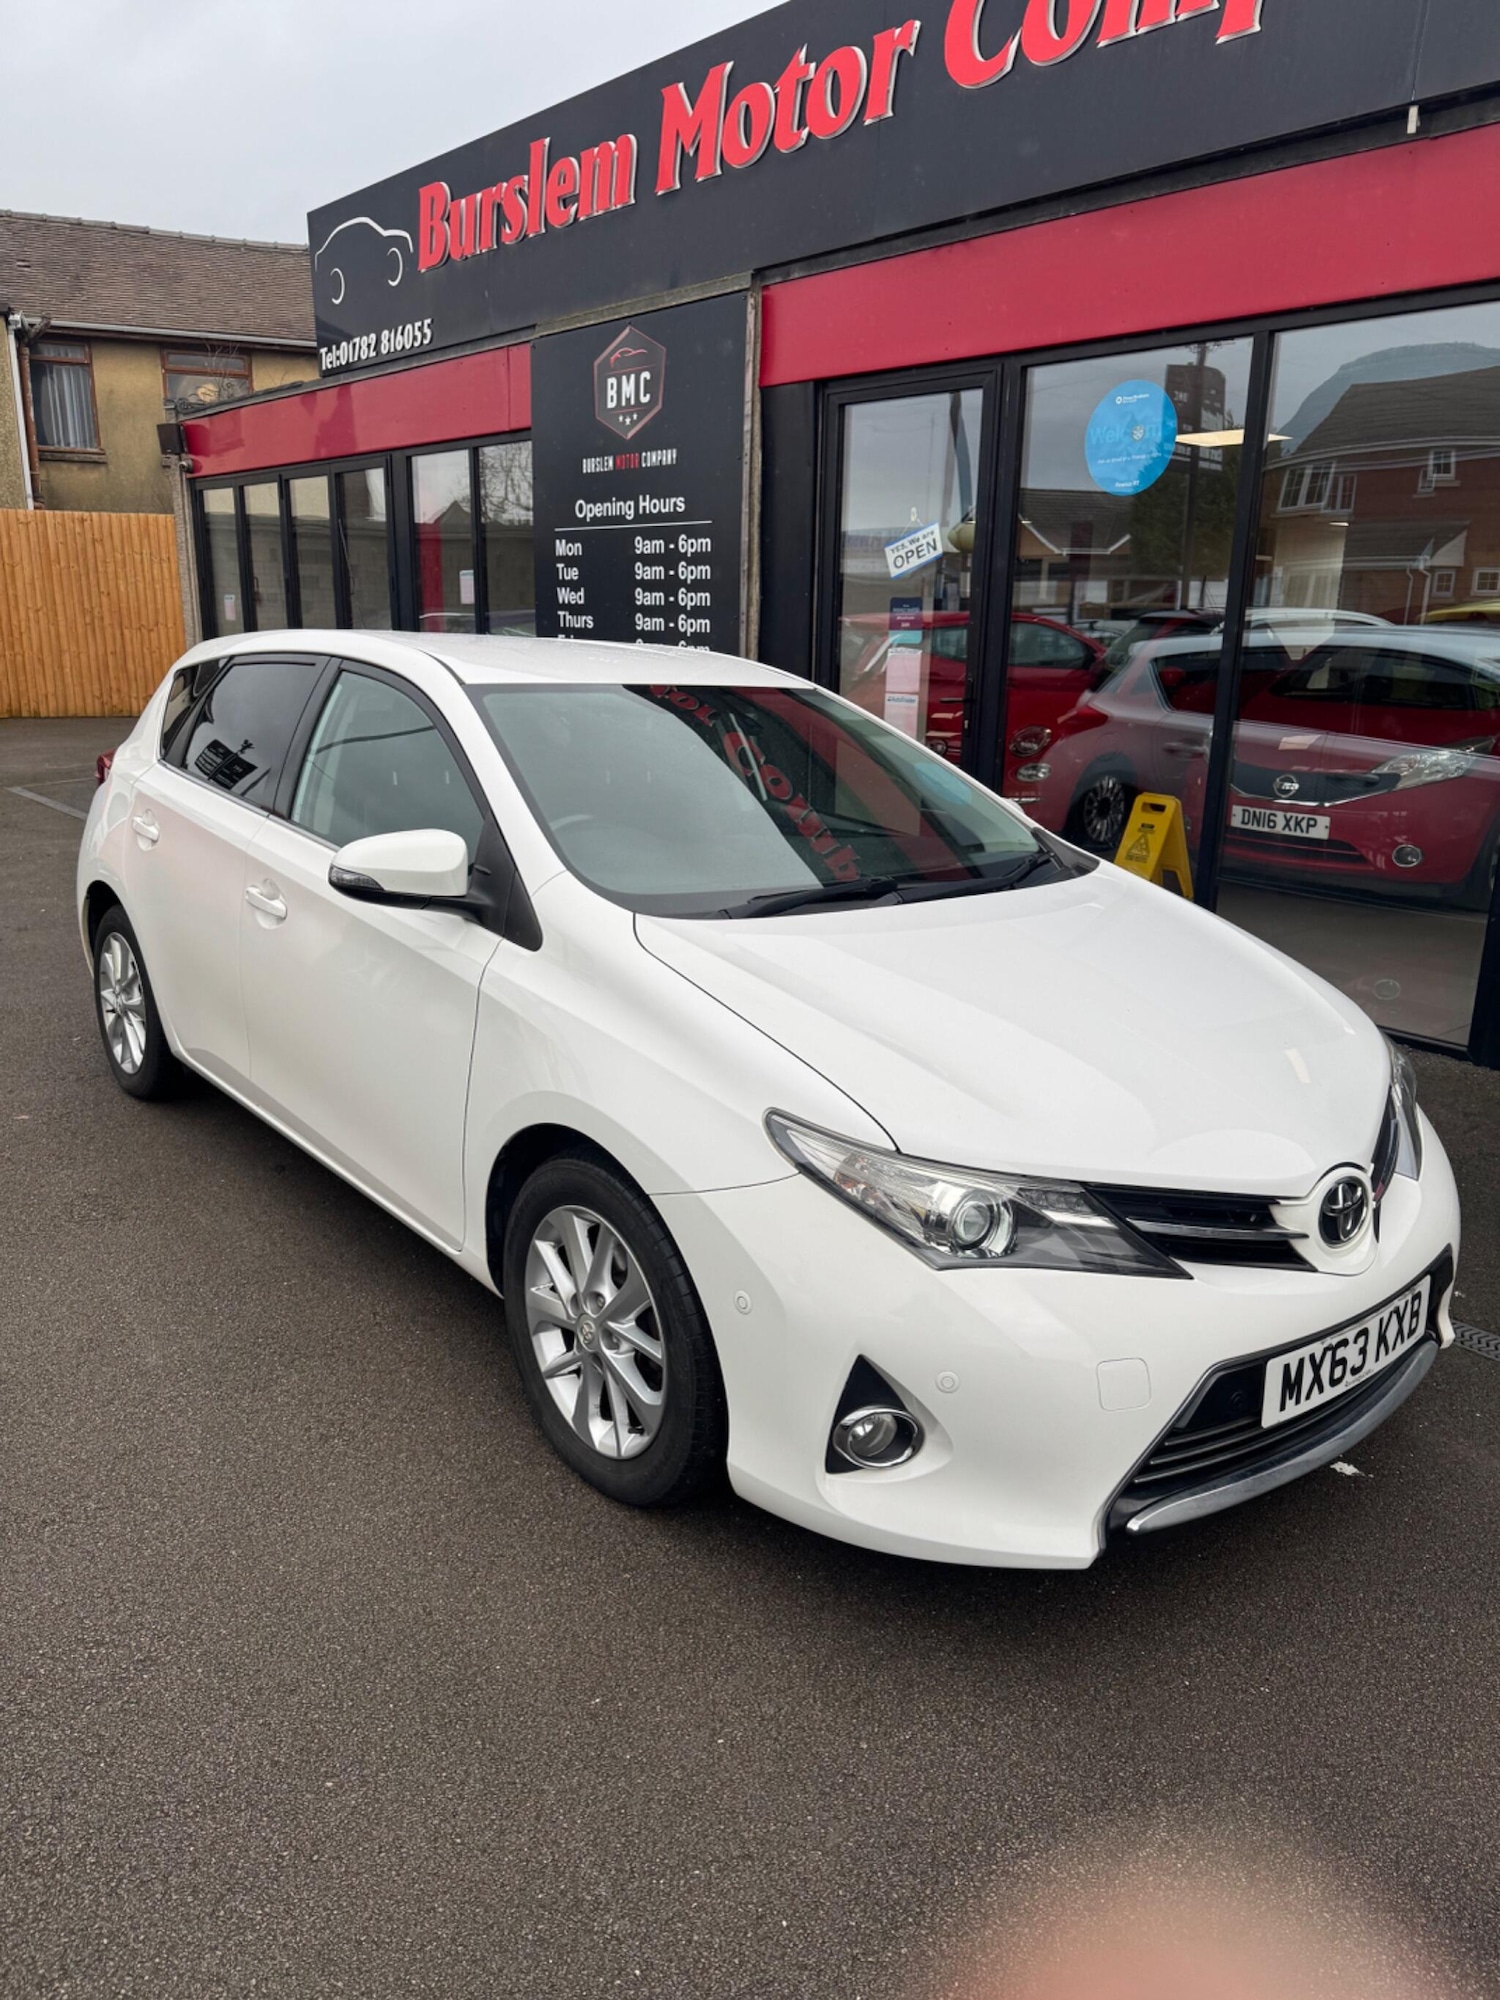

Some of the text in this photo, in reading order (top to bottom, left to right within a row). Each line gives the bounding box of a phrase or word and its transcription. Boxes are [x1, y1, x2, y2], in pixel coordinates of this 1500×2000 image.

[418, 135, 636, 272] Burslem
[656, 19, 920, 195] Motor
[320, 318, 432, 371] Tel:01782 816055
[606, 370, 651, 409] BMC
[582, 456, 614, 474] BURSLEM
[641, 448, 677, 468] COMPANY
[575, 494, 685, 522] Opening Hours
[555, 539, 582, 557] Mon
[634, 536, 665, 554] 9am
[678, 534, 711, 557] 6pm
[893, 537, 938, 569] OPEN
[556, 564, 579, 581] Tue
[634, 562, 665, 580] 9am
[678, 561, 711, 583] 6pm
[557, 587, 584, 605] Wed
[634, 587, 665, 605] 9am
[678, 587, 711, 610] 6pm
[557, 611, 594, 629] Thurs
[634, 613, 665, 631] 9am
[678, 613, 711, 637] 6pm
[1241, 808, 1318, 835] DN16 XKP
[1279, 1290, 1423, 1413] MX63 KXB
